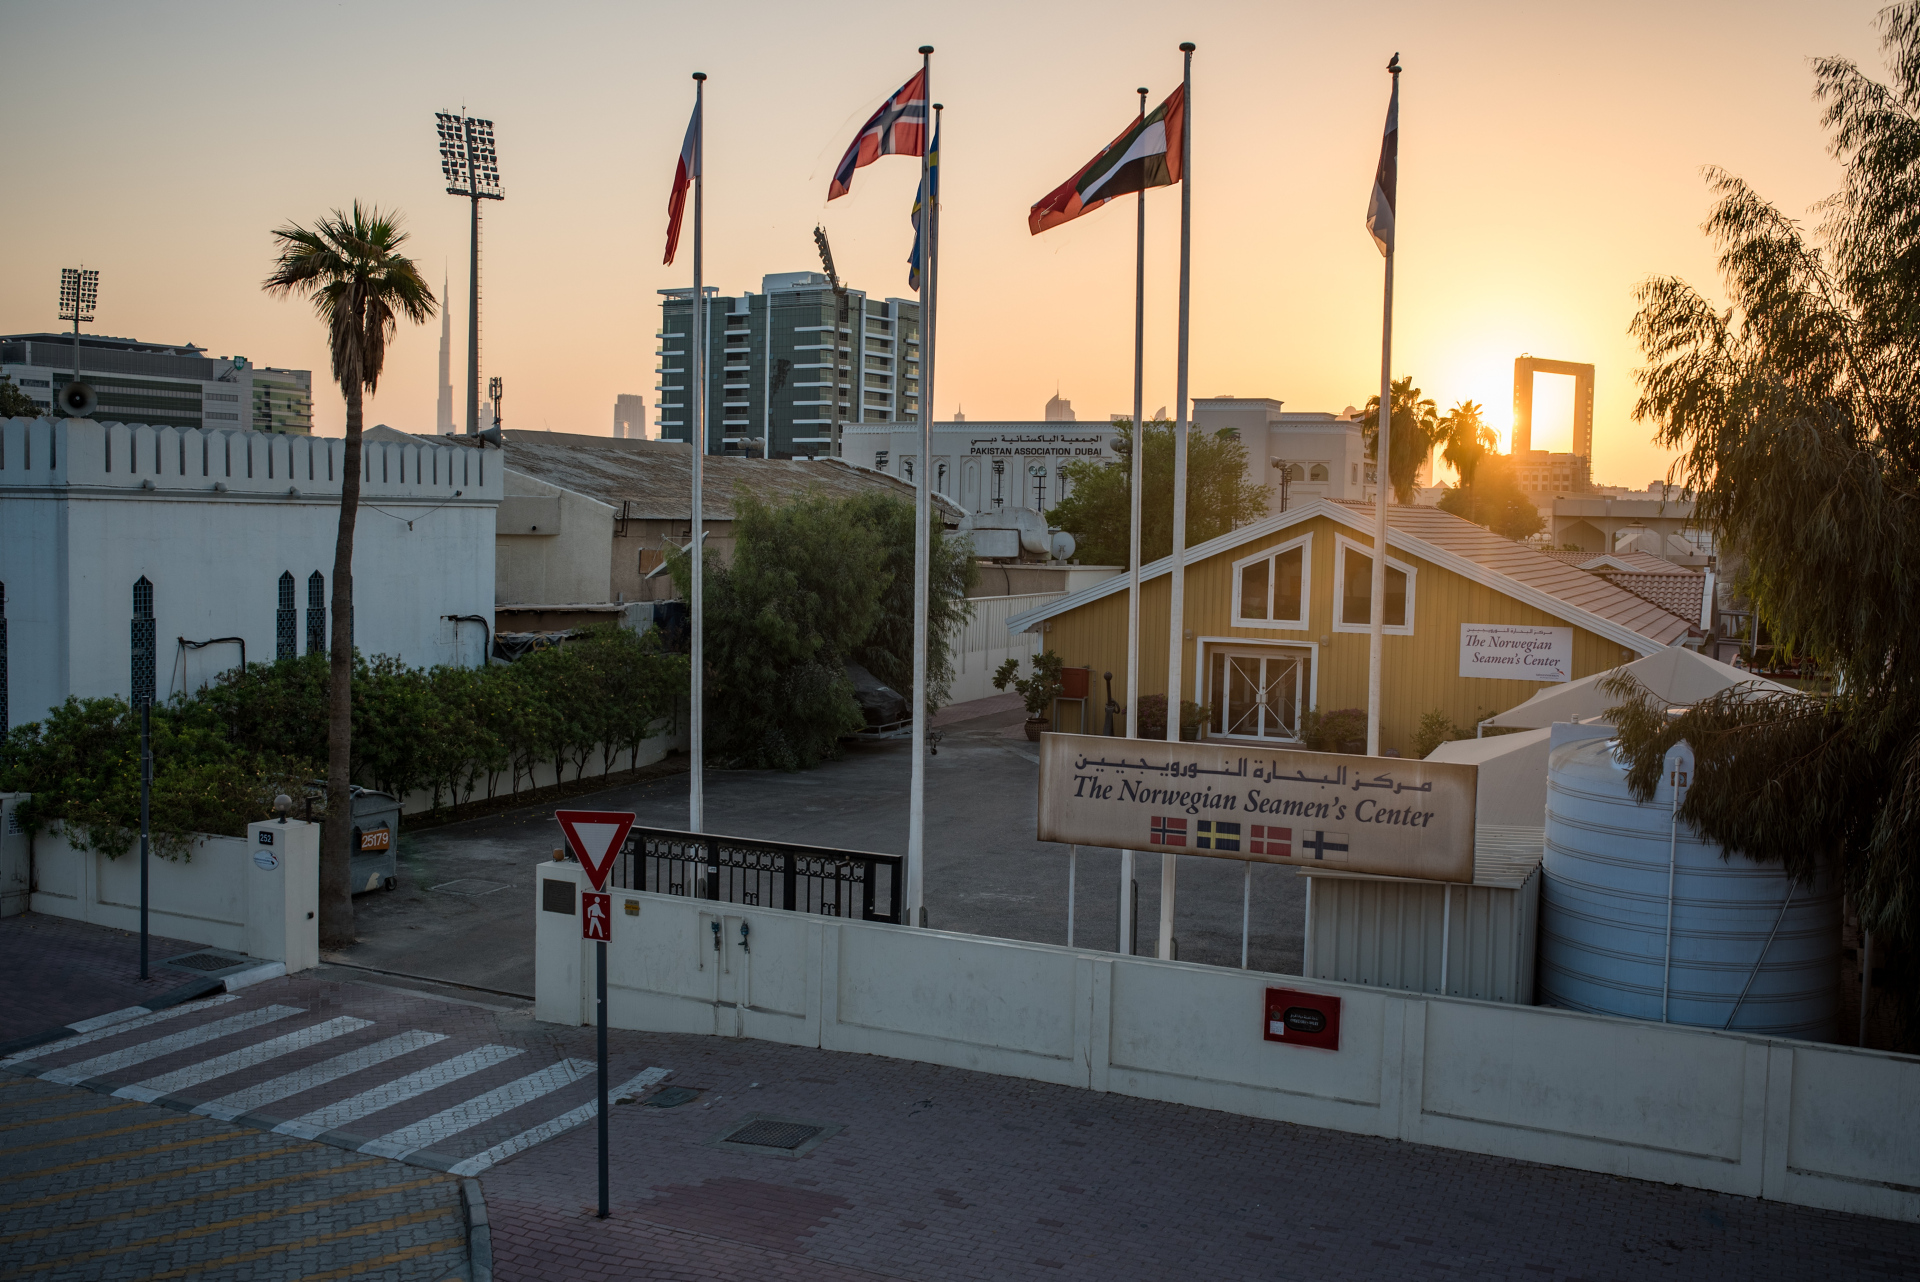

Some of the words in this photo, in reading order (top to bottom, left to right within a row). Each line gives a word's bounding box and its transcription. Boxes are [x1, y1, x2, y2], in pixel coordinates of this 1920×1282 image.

[970, 436, 998, 446] دبي
[1001, 435, 1059, 444] الباكستانية
[1060, 435, 1102, 444] الجمعية
[970, 447, 1012, 455] PAKISTAN
[1014, 447, 1071, 456] ASSOCIATION
[1074, 447, 1102, 456] DUBAI
[1465, 634, 1486, 647] The
[1487, 635, 1552, 653] Norwegian
[1472, 651, 1521, 665] Seamen's
[1523, 654, 1561, 667] Center
[1074, 753, 1248, 779] النورويجيين
[1253, 760, 1347, 790] البحارة
[1351, 771, 1432, 795] مركز
[1073, 774, 1113, 800] The
[1117, 778, 1237, 815] Norwegian
[1243, 789, 1347, 821] Seamen's
[1354, 798, 1435, 828] Center
[259, 833, 272, 843] 252
[361, 832, 389, 848] 25179
